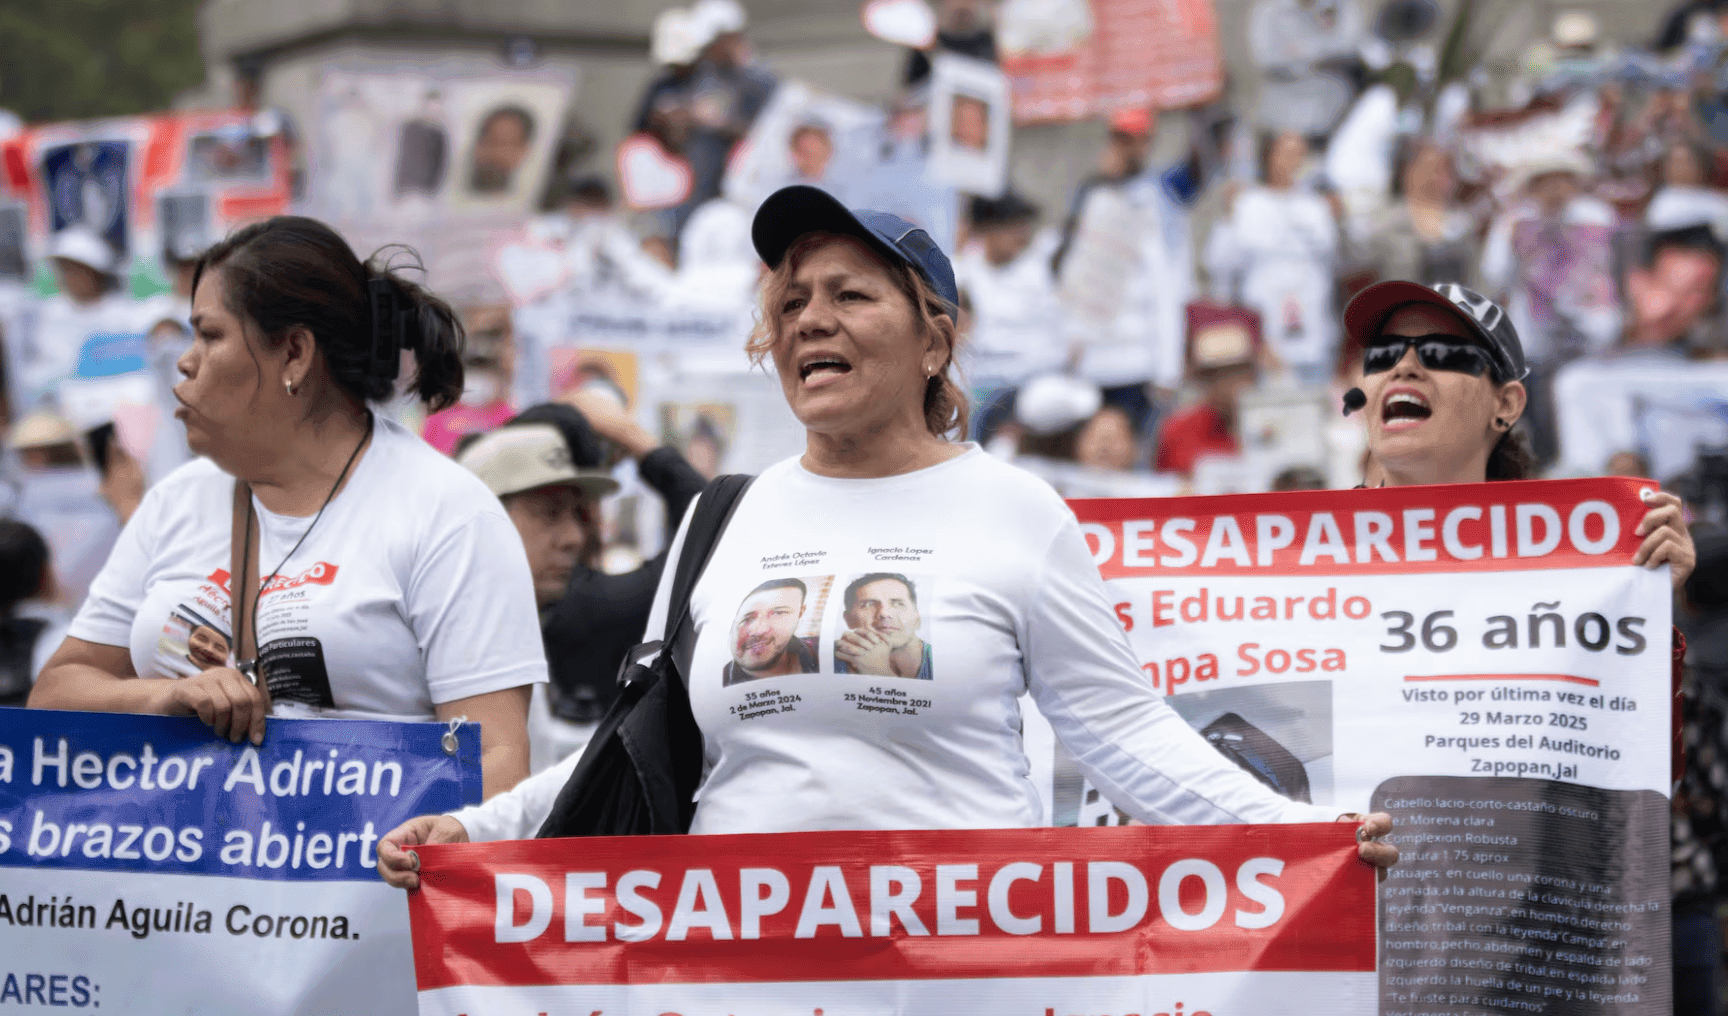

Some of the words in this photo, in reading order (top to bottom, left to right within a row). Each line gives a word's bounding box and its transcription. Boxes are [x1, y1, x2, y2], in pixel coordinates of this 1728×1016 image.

[1078, 500, 1620, 567] DESAPARECIDO
[760, 553, 790, 563] Andrés
[792, 550, 827, 559] Octavio
[867, 547, 903, 555] Ignacio
[795, 559, 820, 567] López
[1152, 588, 1372, 628] Eduardo
[1379, 610, 1458, 653] 36
[1482, 601, 1646, 656] años
[1236, 643, 1346, 676] Sosa
[745, 692, 757, 701] 35
[759, 690, 781, 698] años
[844, 693, 856, 701] 25
[858, 694, 907, 706] Noviembre
[909, 699, 931, 708] 2021
[869, 687, 882, 695] 45
[884, 688, 907, 697] años
[1402, 689, 1448, 702] Visto
[1454, 690, 1485, 705] por
[1491, 687, 1551, 702] última
[1556, 690, 1585, 706] vez
[1589, 694, 1604, 709] el
[1609, 696, 1637, 712] día
[729, 706, 736, 714] 2
[737, 704, 748, 712] de
[749, 700, 776, 709] Marzo
[777, 694, 802, 704] 2024
[1459, 712, 1480, 725] 29
[1486, 711, 1543, 725] Marzo
[1549, 713, 1588, 731] 2025
[1425, 735, 1500, 751] Parques
[1505, 734, 1533, 749] del
[1539, 737, 1620, 760] Auditorio
[32, 737, 214, 791] Hector
[224, 746, 402, 797] Adrian
[1410, 815, 1460, 826] Morena
[1464, 815, 1495, 827] clara
[1558, 806, 1598, 820] oscuro
[27, 810, 203, 863] brazos
[1465, 833, 1518, 845] Robusta
[1473, 852, 1509, 864] aprox
[1446, 869, 1462, 879] en
[1466, 869, 1503, 880] cuello
[1507, 873, 1531, 882] una
[1534, 874, 1576, 889] corona
[1579, 883, 1585, 893] y
[1588, 883, 1612, 894] una
[495, 857, 1286, 944] DESAPARECIDOS
[1453, 884, 1464, 896] la
[1468, 886, 1505, 898] altura
[1509, 889, 1524, 900] de
[1528, 890, 1538, 901] la
[1594, 901, 1645, 913] derecha
[1648, 901, 1659, 911] la
[0, 894, 96, 929] Adrián
[105, 899, 212, 939] Aguila
[225, 904, 360, 940] Corona.
[1580, 917, 1632, 931] derecho
[1469, 924, 1492, 932] con
[1496, 923, 1507, 935] la
[1545, 950, 1553, 962] y
[1555, 951, 1602, 966] espalda
[1605, 956, 1621, 966] de
[1385, 957, 1447, 970] izquierdo
[1496, 960, 1512, 971] de
[1567, 971, 1615, 985] espalda
[1618, 973, 1647, 985] lado
[0, 973, 100, 1008] ARES:
[1386, 973, 1447, 987] izquierdo
[1450, 974, 1461, 985] la
[1465, 975, 1503, 989] huella
[1507, 981, 1522, 991] de
[1525, 983, 1540, 993] un
[1544, 985, 1563, 998] pie
[1565, 990, 1573, 1001] y
[1575, 989, 1586, 1000] la
[1589, 990, 1639, 1005] leyenda
[1449, 994, 1479, 1006] para
